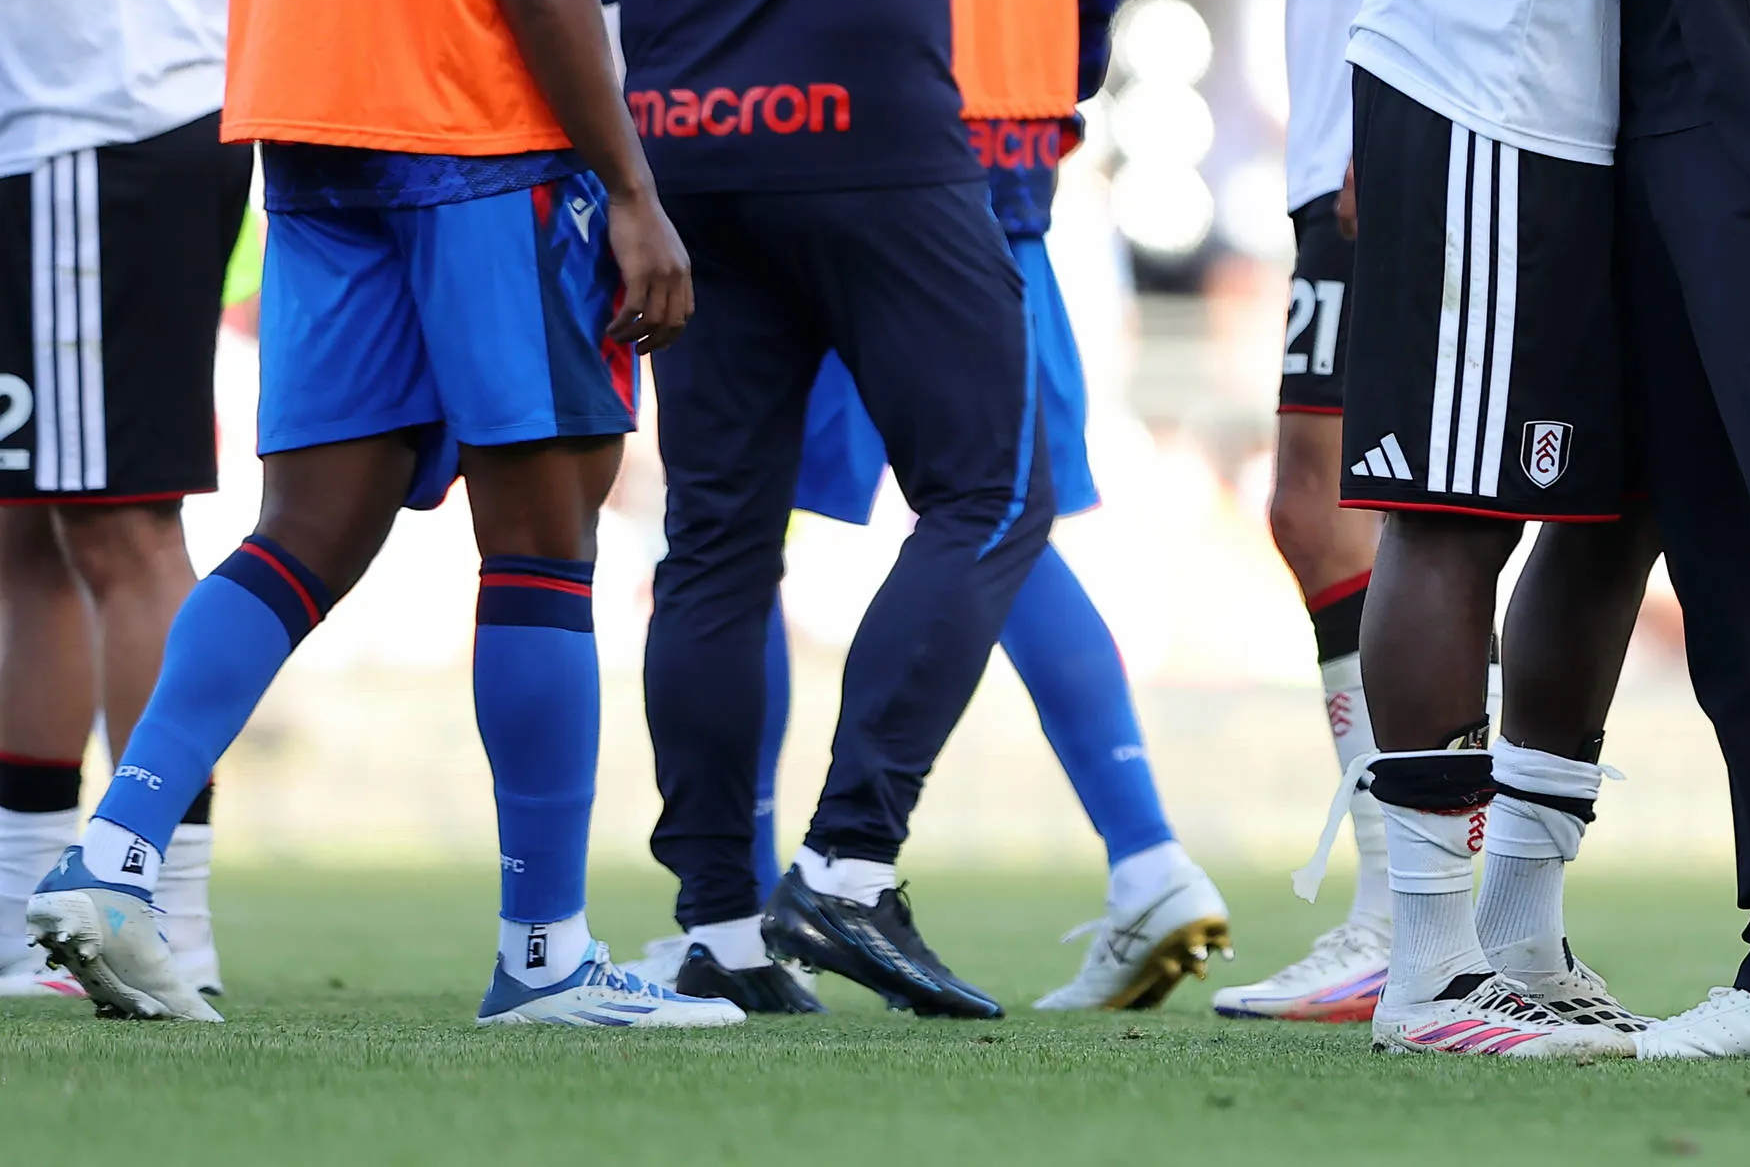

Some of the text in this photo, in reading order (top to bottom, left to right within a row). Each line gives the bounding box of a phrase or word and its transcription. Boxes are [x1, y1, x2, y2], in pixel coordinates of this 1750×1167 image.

[628, 82, 850, 138] macron
[1283, 278, 1345, 375] 21
[1536, 430, 1559, 474] FFC
